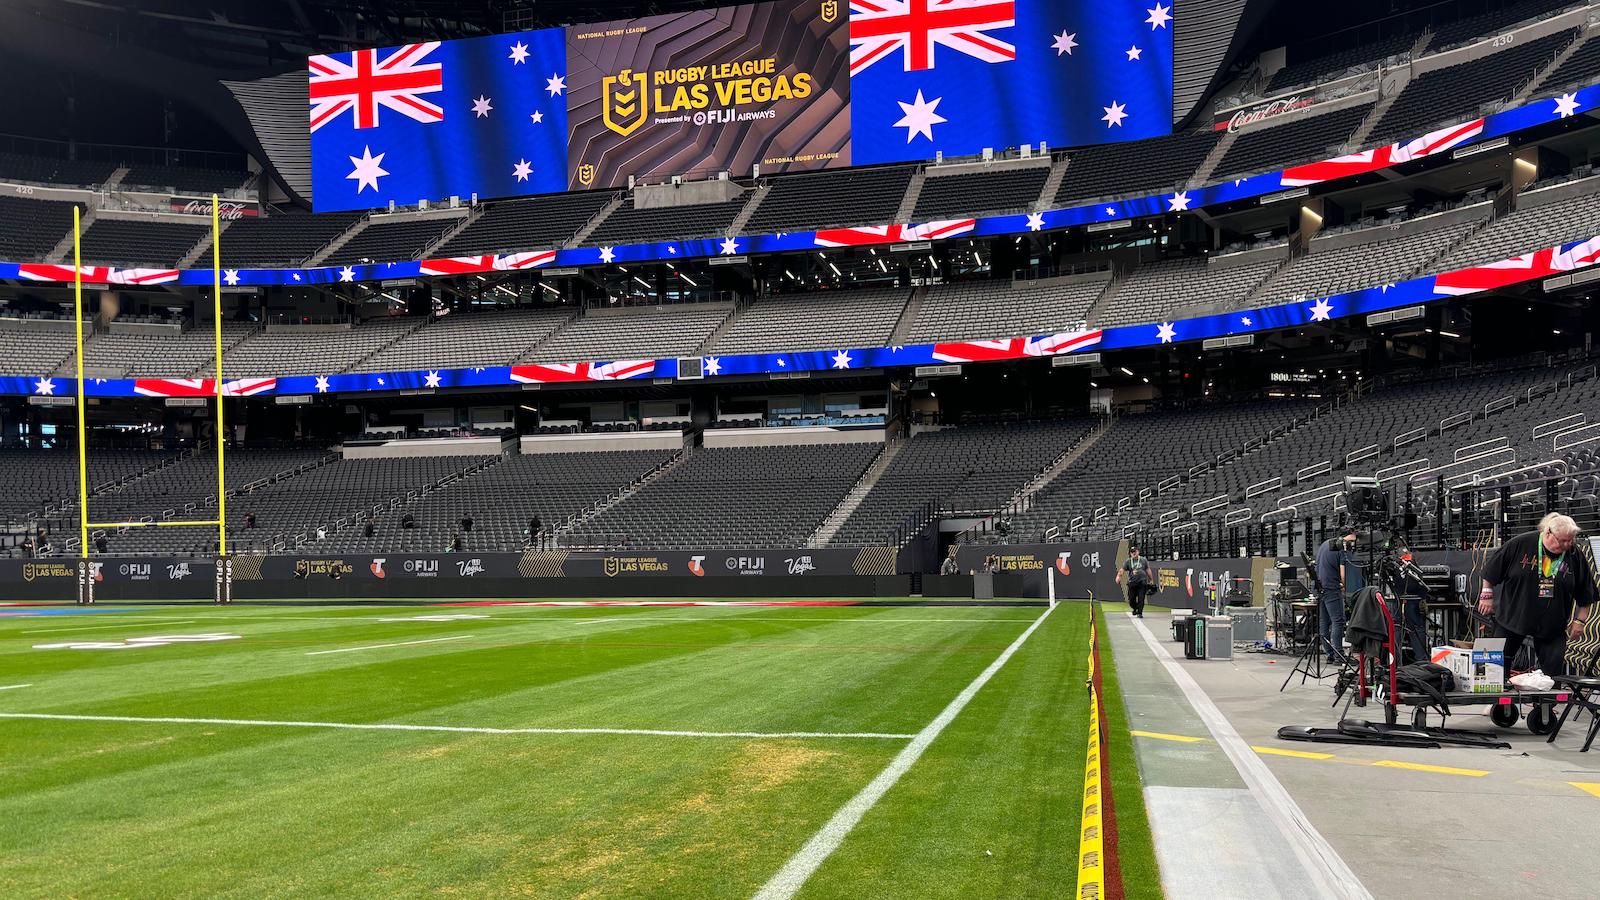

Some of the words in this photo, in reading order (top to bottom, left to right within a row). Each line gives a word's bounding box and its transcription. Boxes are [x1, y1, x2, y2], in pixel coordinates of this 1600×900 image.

[577, 31, 605, 40] NATIONAL
[625, 26, 647, 34] LEAGUE
[1492, 35, 1513, 47] 430
[654, 65, 708, 86] RUGBY
[711, 58, 776, 80] LEAGUE
[654, 83, 709, 113] LAS
[714, 72, 812, 107] VEGAS
[654, 115, 683, 125] Presented
[683, 115, 692, 123] by
[707, 108, 736, 124] FIJI
[737, 109, 776, 121] AIRWAYS
[764, 156, 794, 165] NATIONAL
[794, 154, 815, 162] RUGBY
[815, 152, 839, 160] LEAGUE
[15, 185, 34, 195] 420
[183, 200, 247, 220] CocaCola
[130, 564, 151, 575] FIJI
[311, 565, 326, 574] LAS
[415, 560, 439, 572] FIJI
[620, 563, 637, 571] LAS
[639, 563, 669, 571] VEGAS
[738, 557, 765, 570] FIJI
[1001, 562, 1017, 570] LAS
[1018, 560, 1044, 570] VEGAS
[36, 569, 50, 577] LAS
[50, 569, 74, 577] VEGAS
